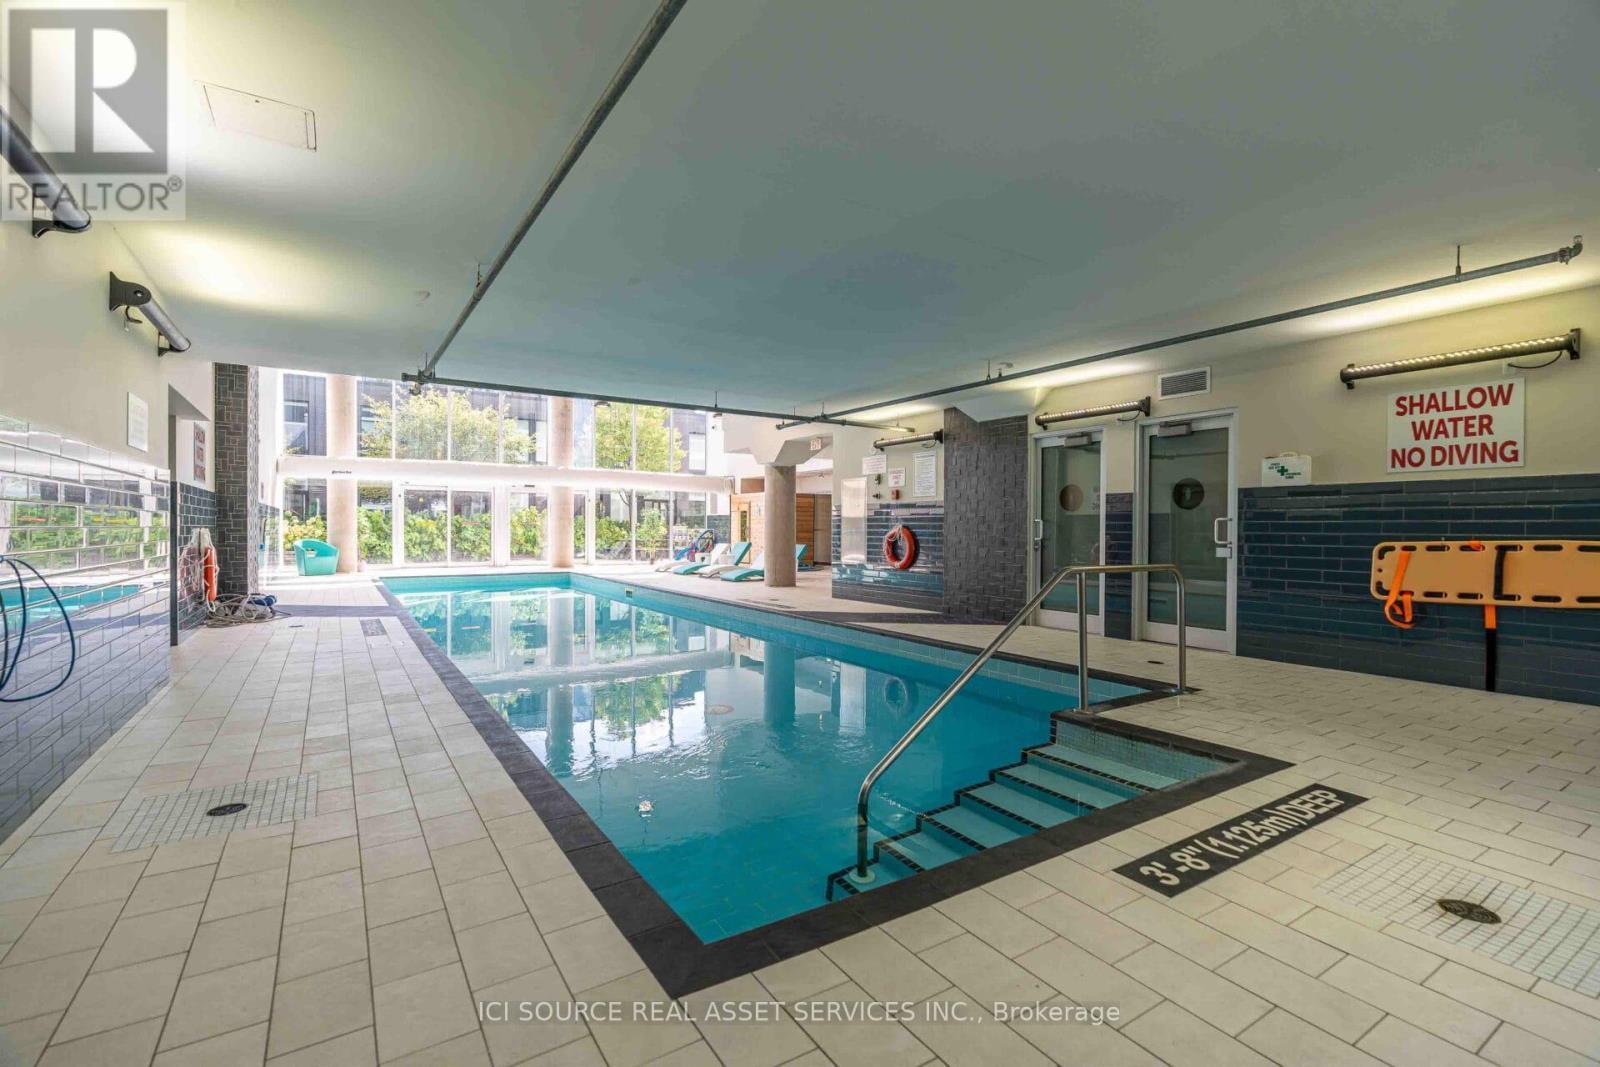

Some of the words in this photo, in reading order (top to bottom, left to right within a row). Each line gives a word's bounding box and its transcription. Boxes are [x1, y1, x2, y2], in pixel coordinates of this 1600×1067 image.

[1395, 383, 1514, 417] SHALLOW
[1411, 414, 1494, 441] WATER
[1391, 447, 1426, 469] NO
[1430, 440, 1519, 467] DIVING
[1275, 789, 1345, 820] DEEP
